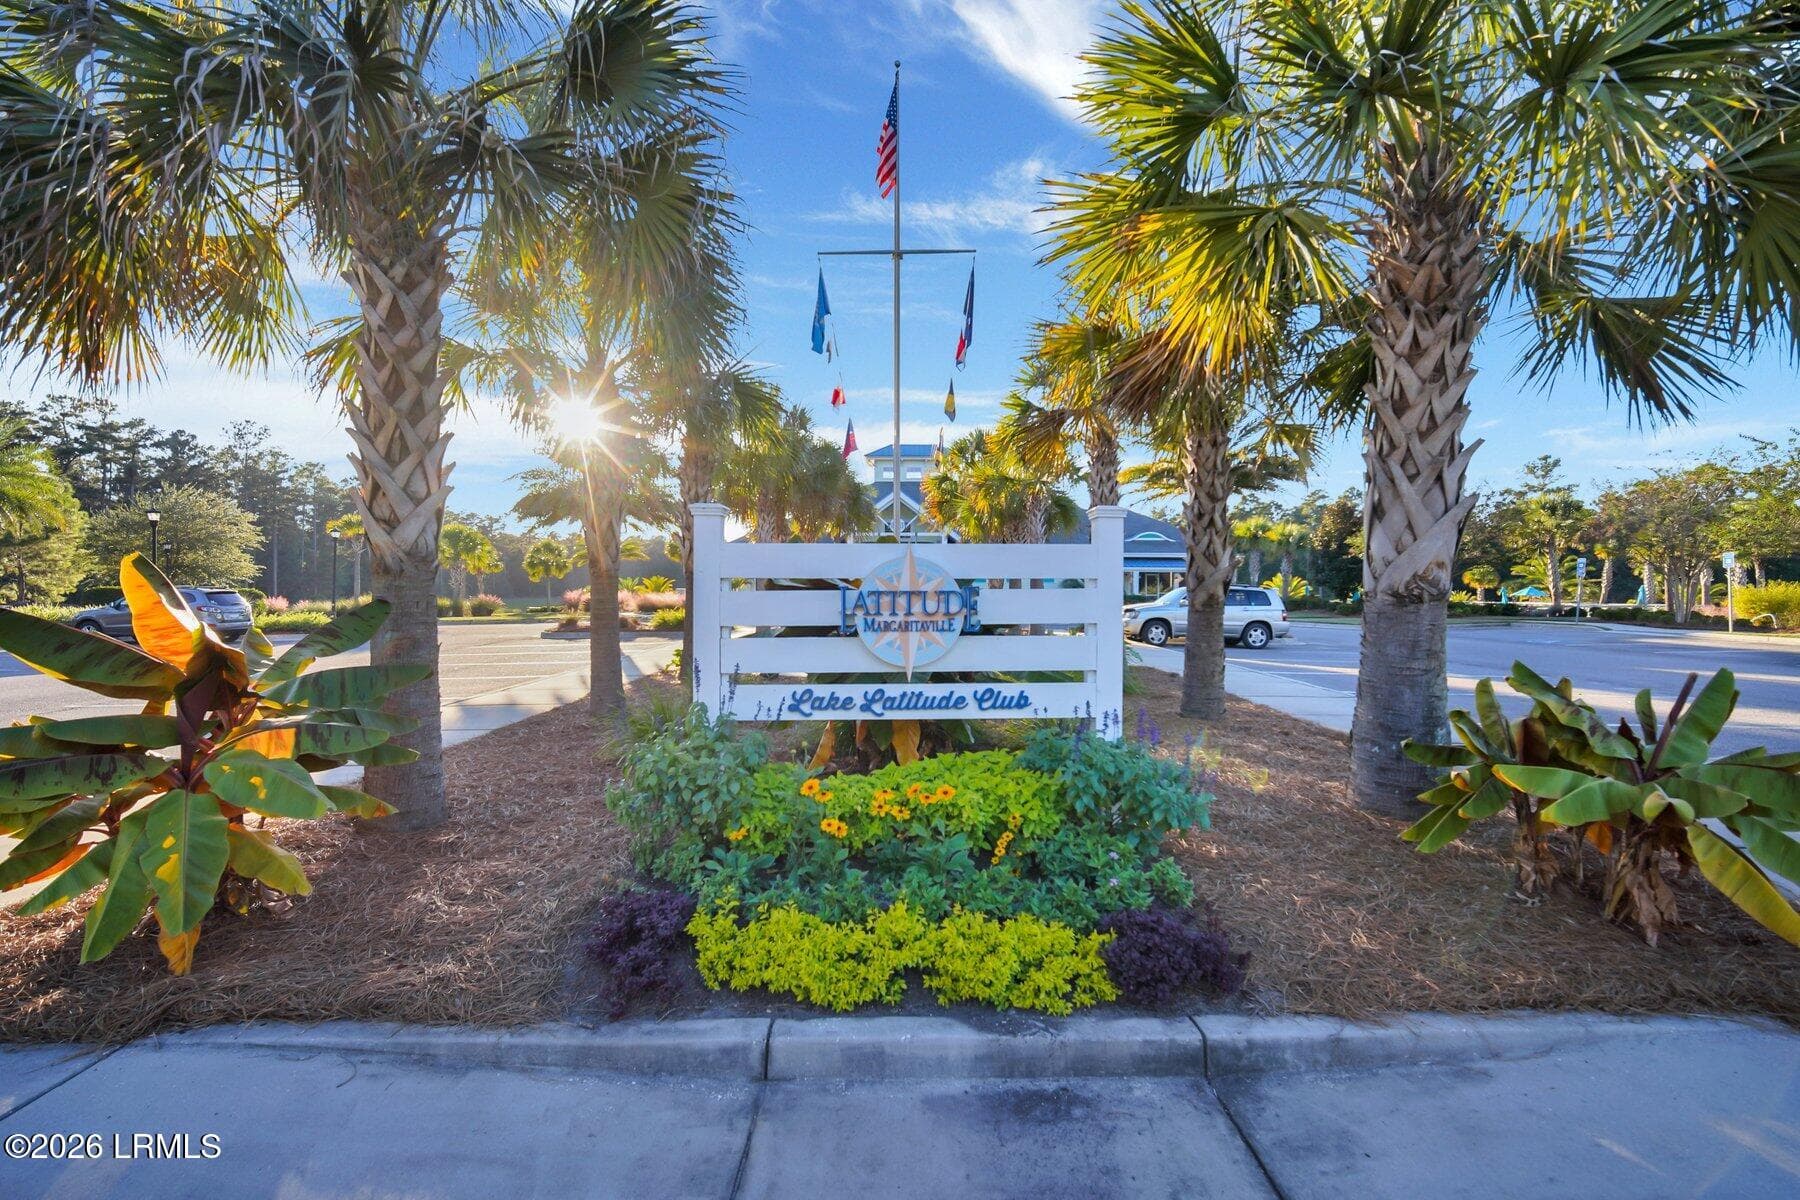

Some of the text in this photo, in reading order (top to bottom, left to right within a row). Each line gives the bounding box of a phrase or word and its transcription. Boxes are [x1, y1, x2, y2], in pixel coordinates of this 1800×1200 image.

[839, 586, 981, 634] LATITUDE
[863, 617, 956, 633] MARGARITAVILLE
[787, 687, 1033, 718] Lake Latitude Club
